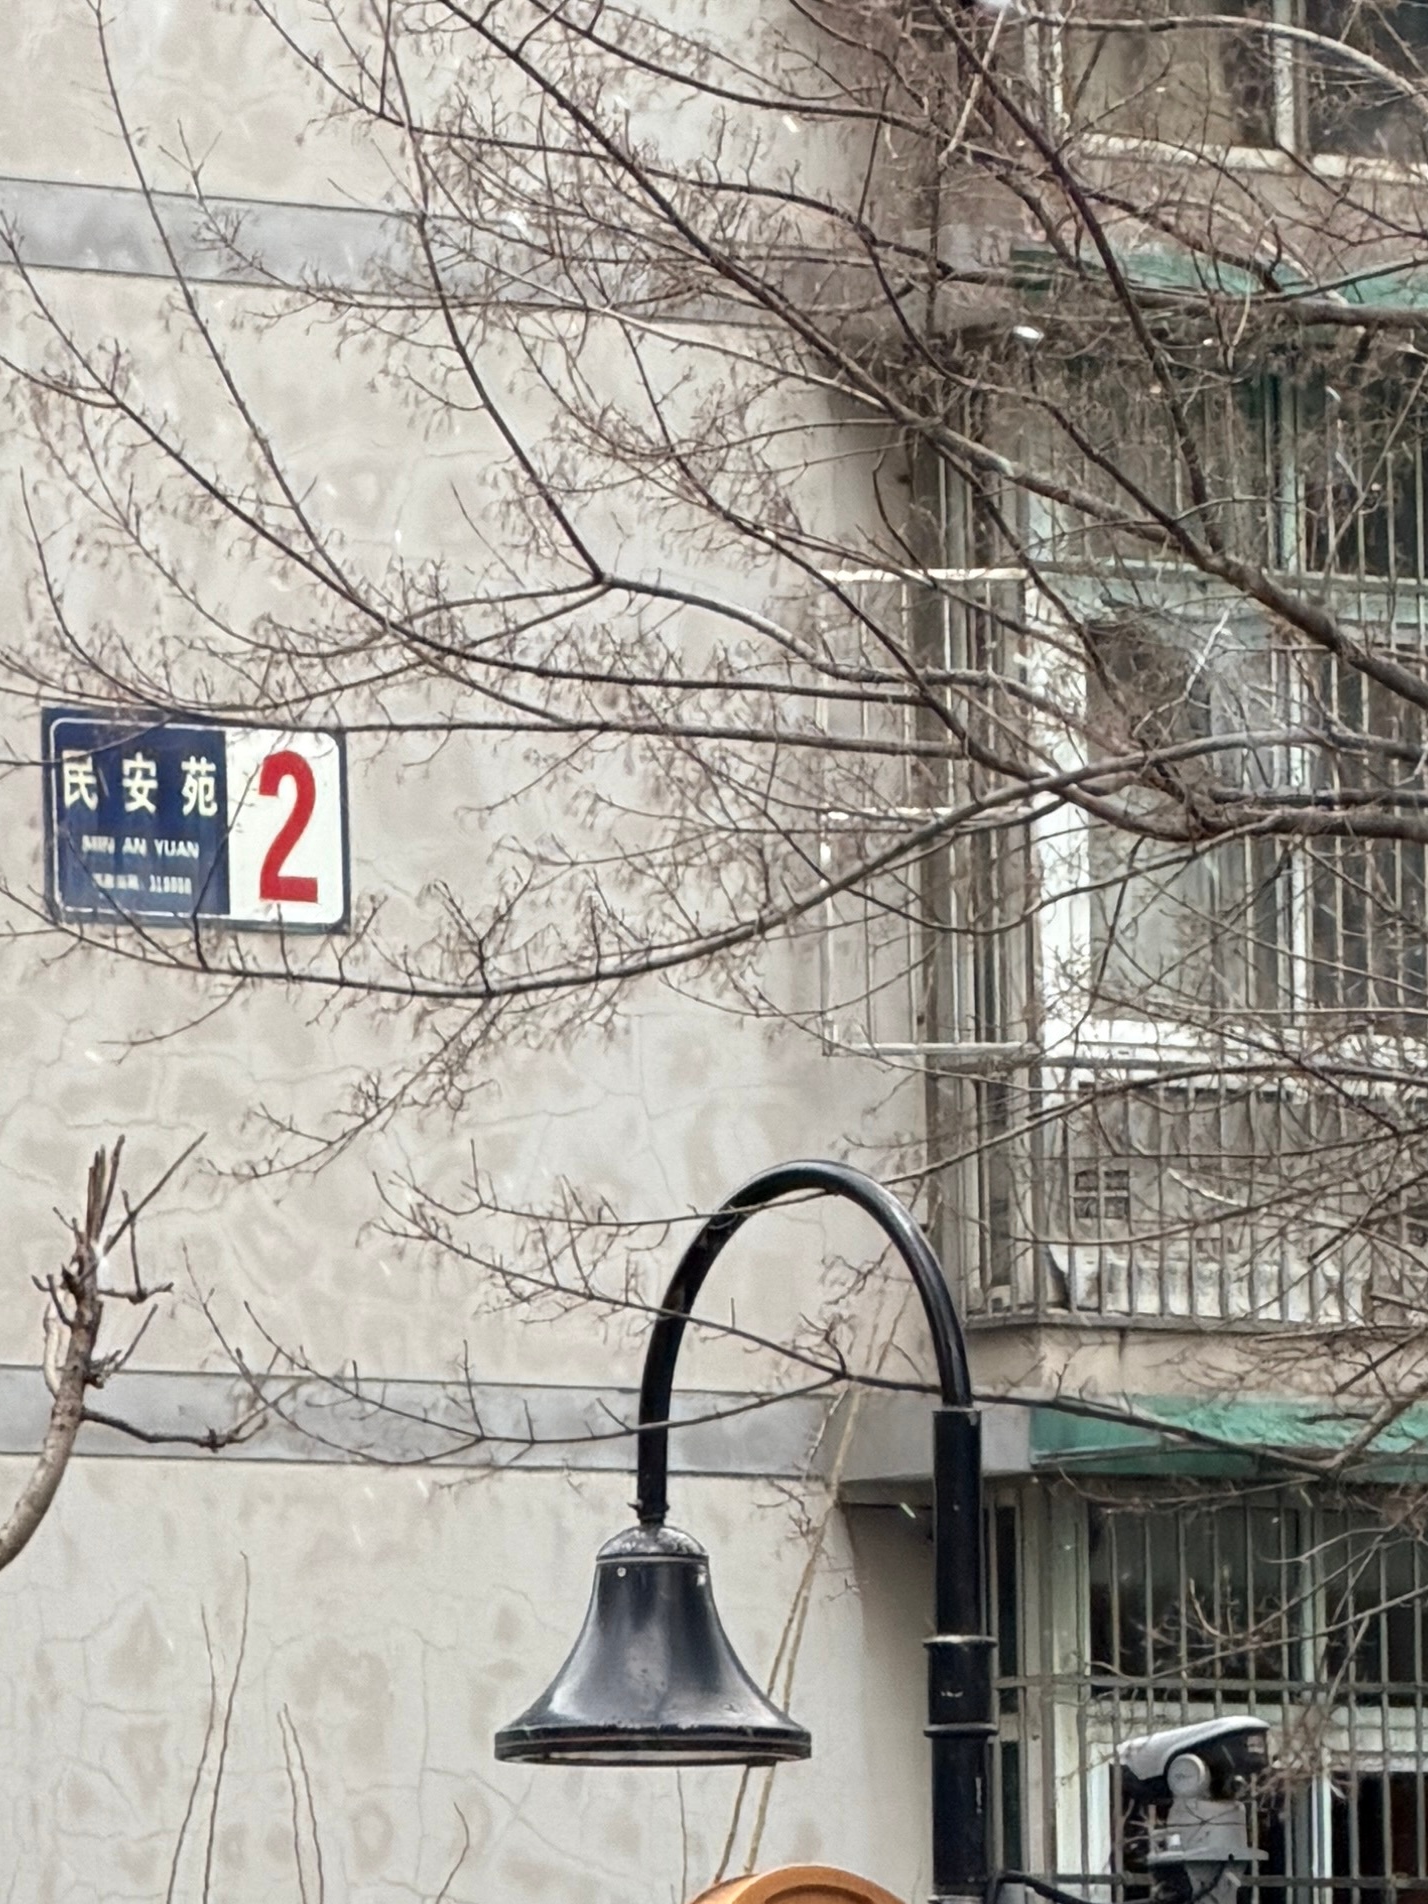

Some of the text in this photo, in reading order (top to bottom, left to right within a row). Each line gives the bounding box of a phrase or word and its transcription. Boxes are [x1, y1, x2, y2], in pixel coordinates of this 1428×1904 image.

[62, 749, 218, 816] 民安苑
[122, 837, 148, 857] AN
[154, 838, 200, 860] YUAN
[258, 749, 319, 904] 2
